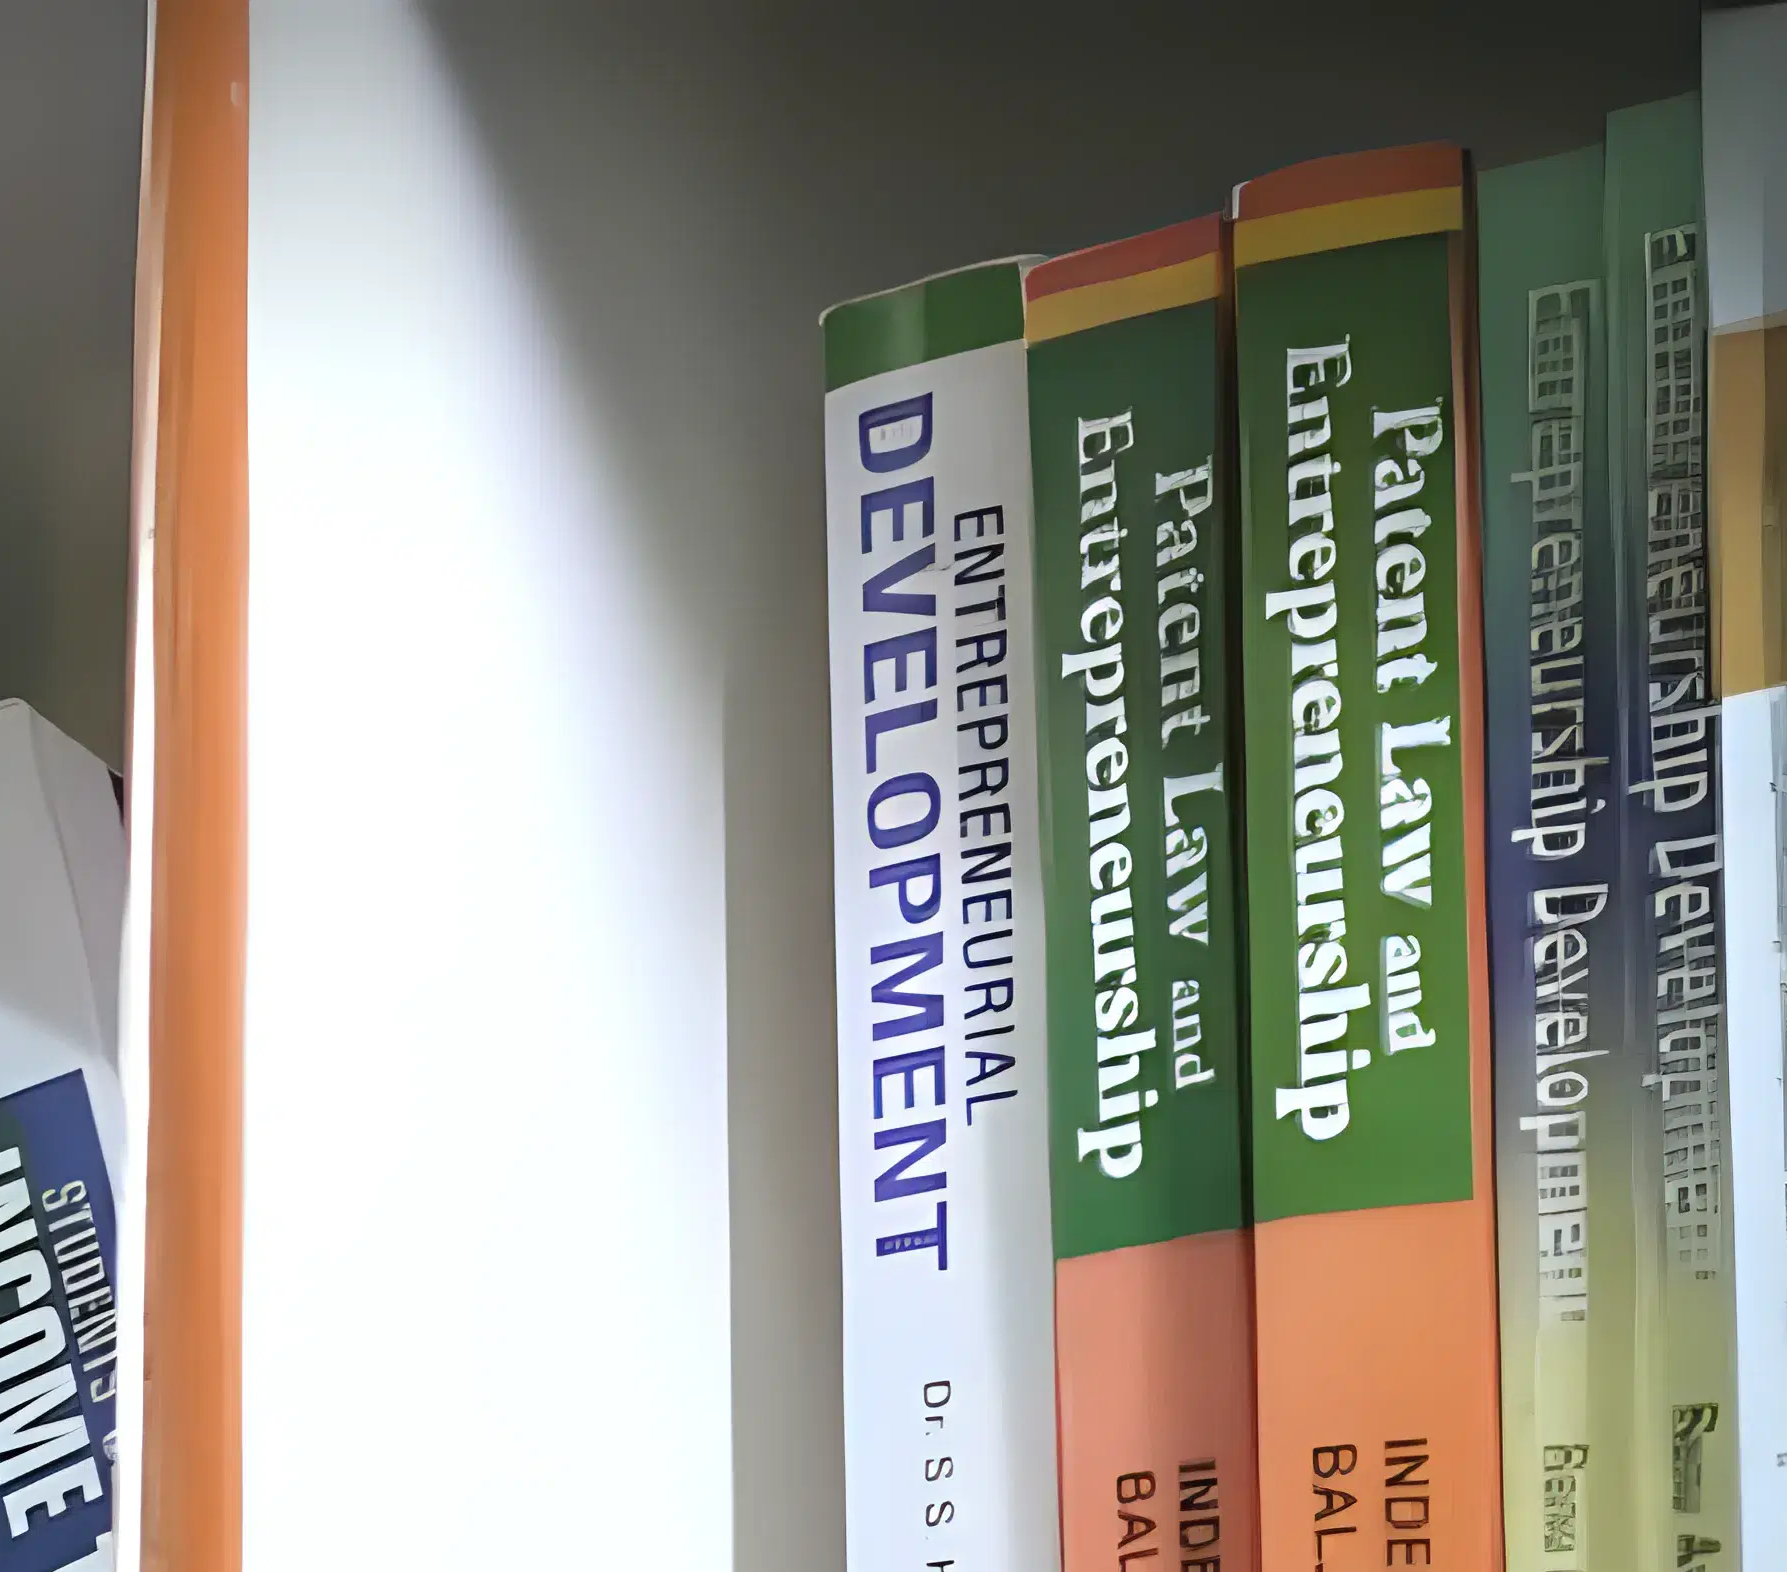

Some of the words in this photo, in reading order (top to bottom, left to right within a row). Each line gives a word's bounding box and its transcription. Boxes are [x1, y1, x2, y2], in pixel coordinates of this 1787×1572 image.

[1153, 453, 1217, 751] Patent
[1369, 395, 1445, 694] Patent
[857, 391, 949, 1272] DEVELOPMENT
[952, 502, 1021, 1127] ENTREPRENEURIAL
[1060, 405, 1158, 1179] Entrepreneurship
[1162, 760, 1225, 947] Law
[1265, 332, 1371, 1143] Entrepreneurship
[1379, 713, 1453, 909] Law
[1172, 976, 1216, 1091] and
[1380, 932, 1438, 1057] and
[923, 1380, 952, 1437] Dr.
